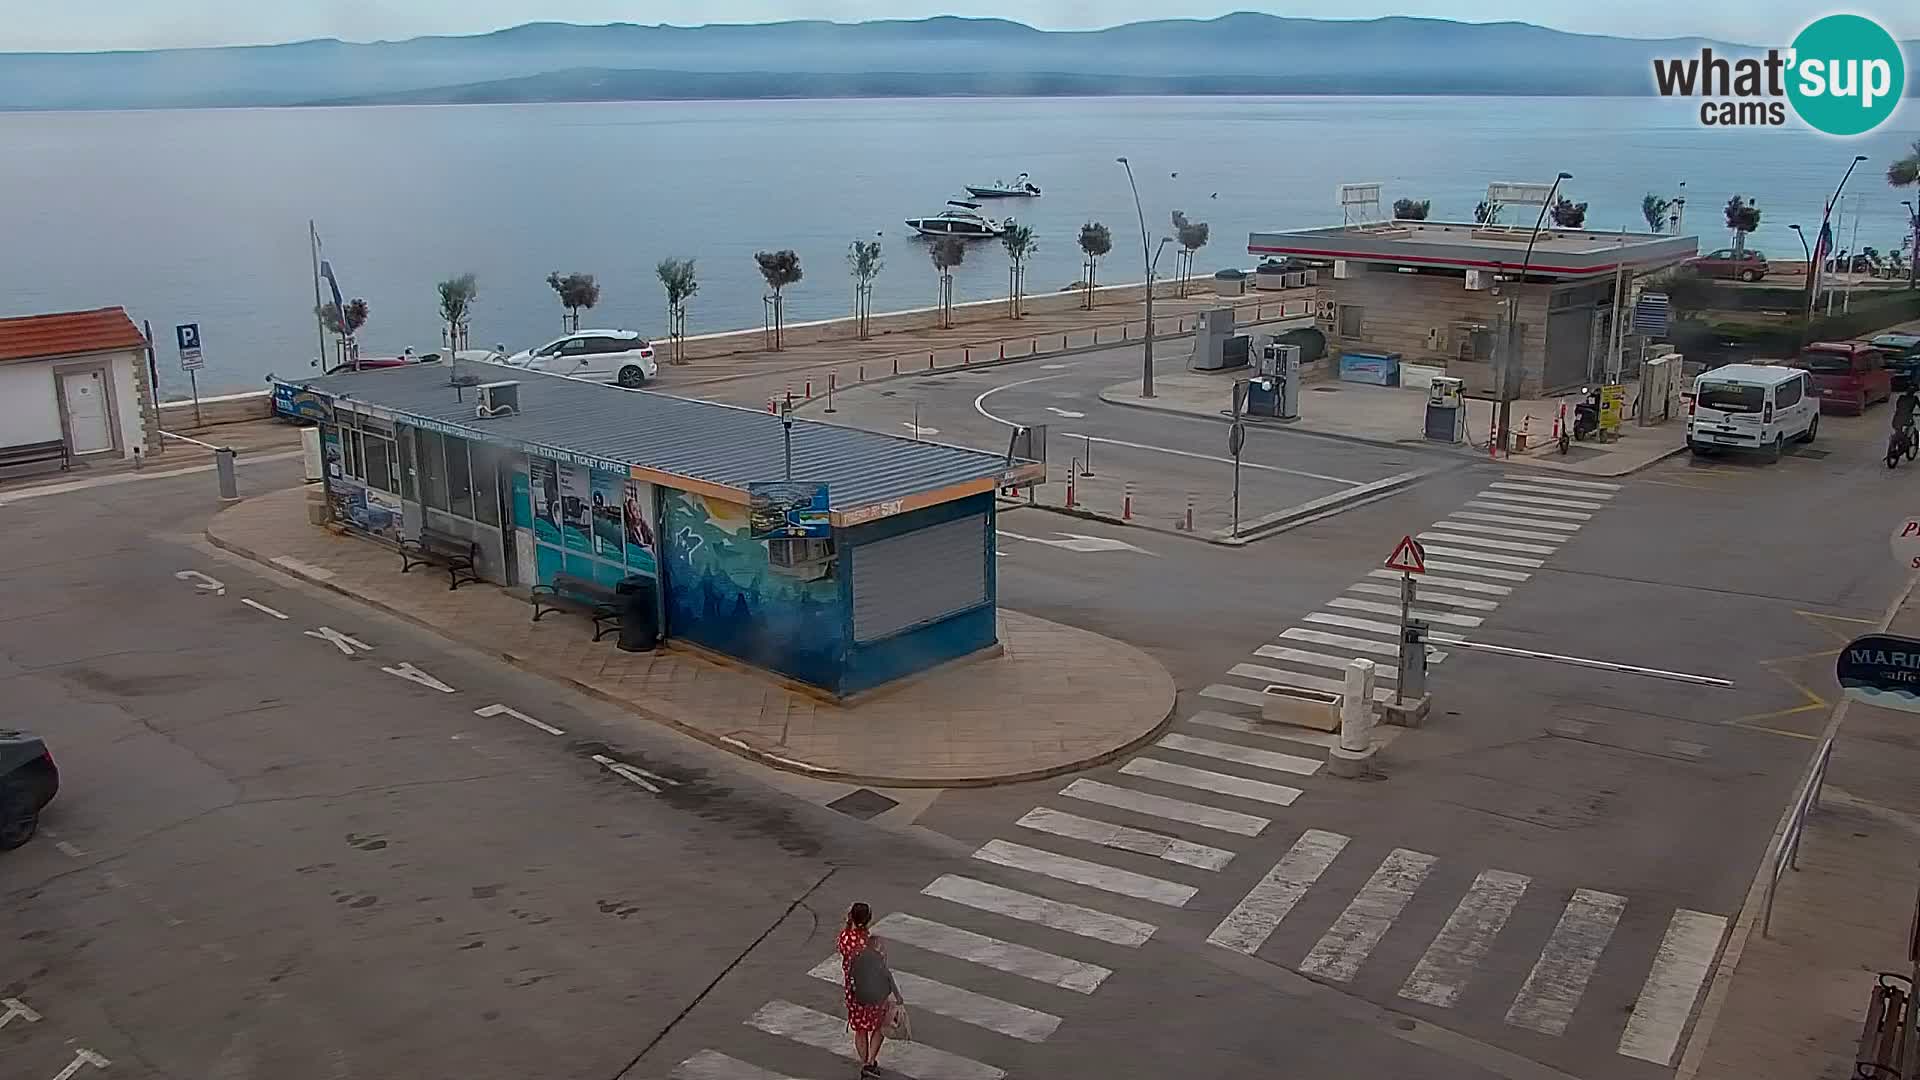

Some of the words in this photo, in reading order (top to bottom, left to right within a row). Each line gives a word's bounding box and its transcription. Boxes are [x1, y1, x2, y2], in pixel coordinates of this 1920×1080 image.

[183, 328, 194, 346] P
[539, 448, 571, 462] STATION
[573, 454, 598, 468] TICKET
[599, 460, 626, 474] OFFICE
